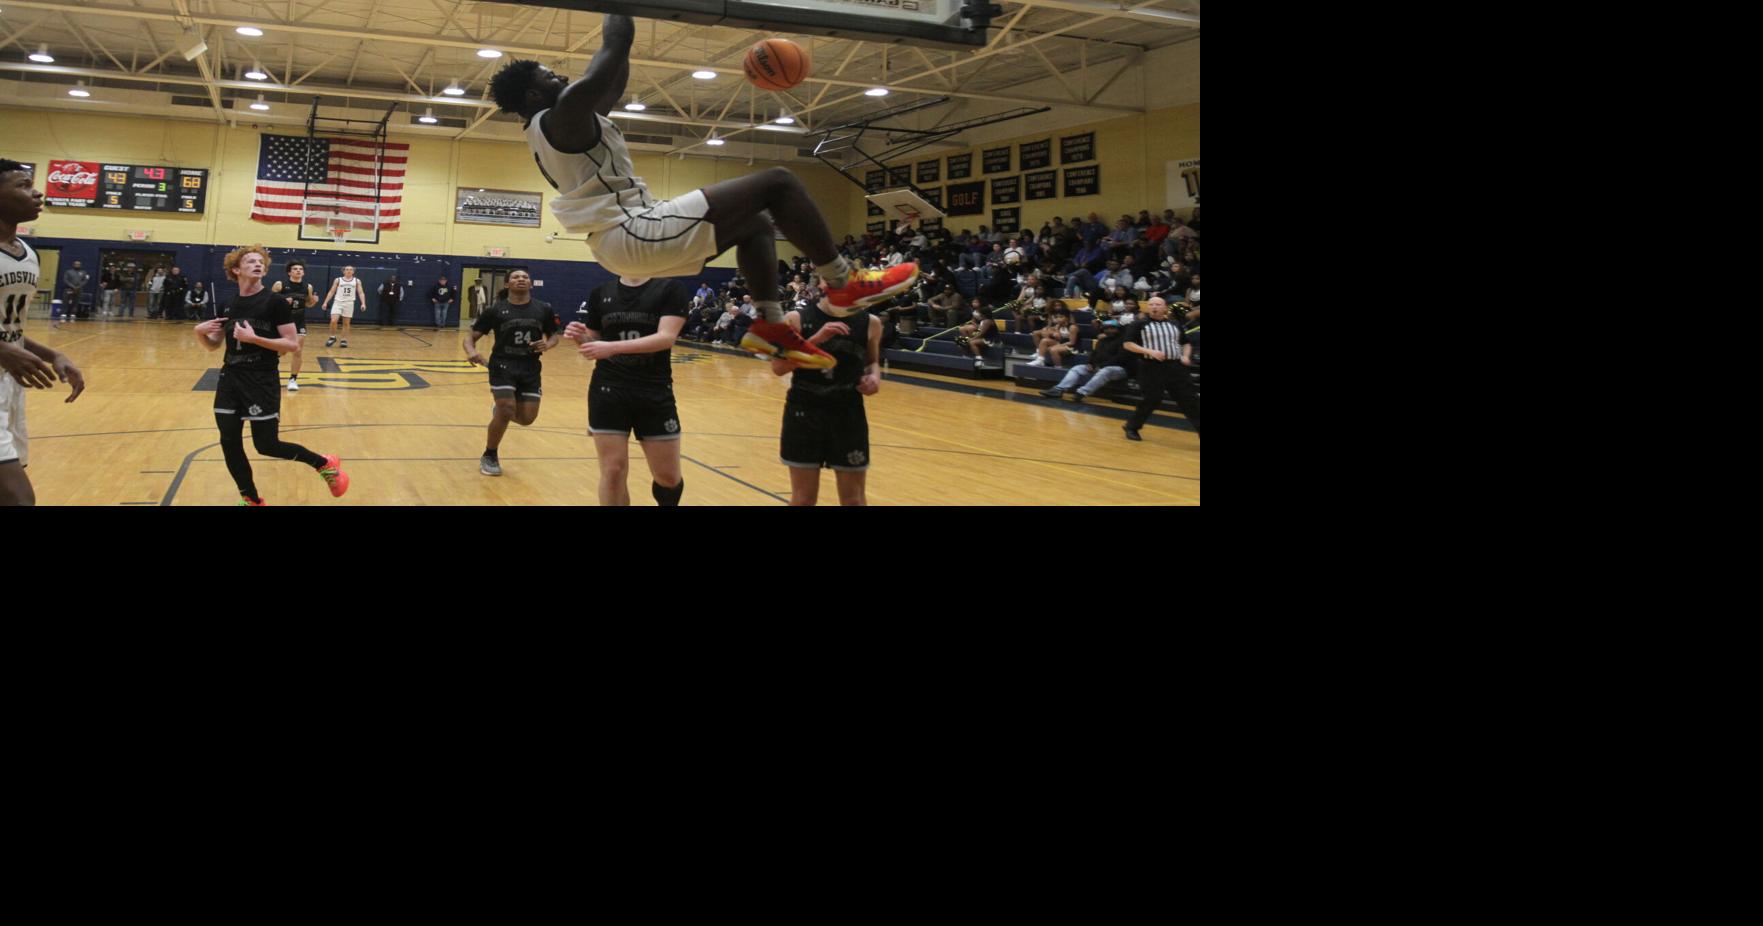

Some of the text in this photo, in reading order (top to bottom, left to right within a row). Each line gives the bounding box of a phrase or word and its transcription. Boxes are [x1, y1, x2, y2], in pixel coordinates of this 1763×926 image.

[108, 172, 126, 184] 43
[183, 176, 201, 188] 68
[158, 182, 167, 192] 3
[111, 196, 119, 205] 5
[185, 200, 194, 209] 5
[952, 191, 978, 207] GOLF
[3, 294, 27, 324] 11
[514, 330, 531, 345] 24
